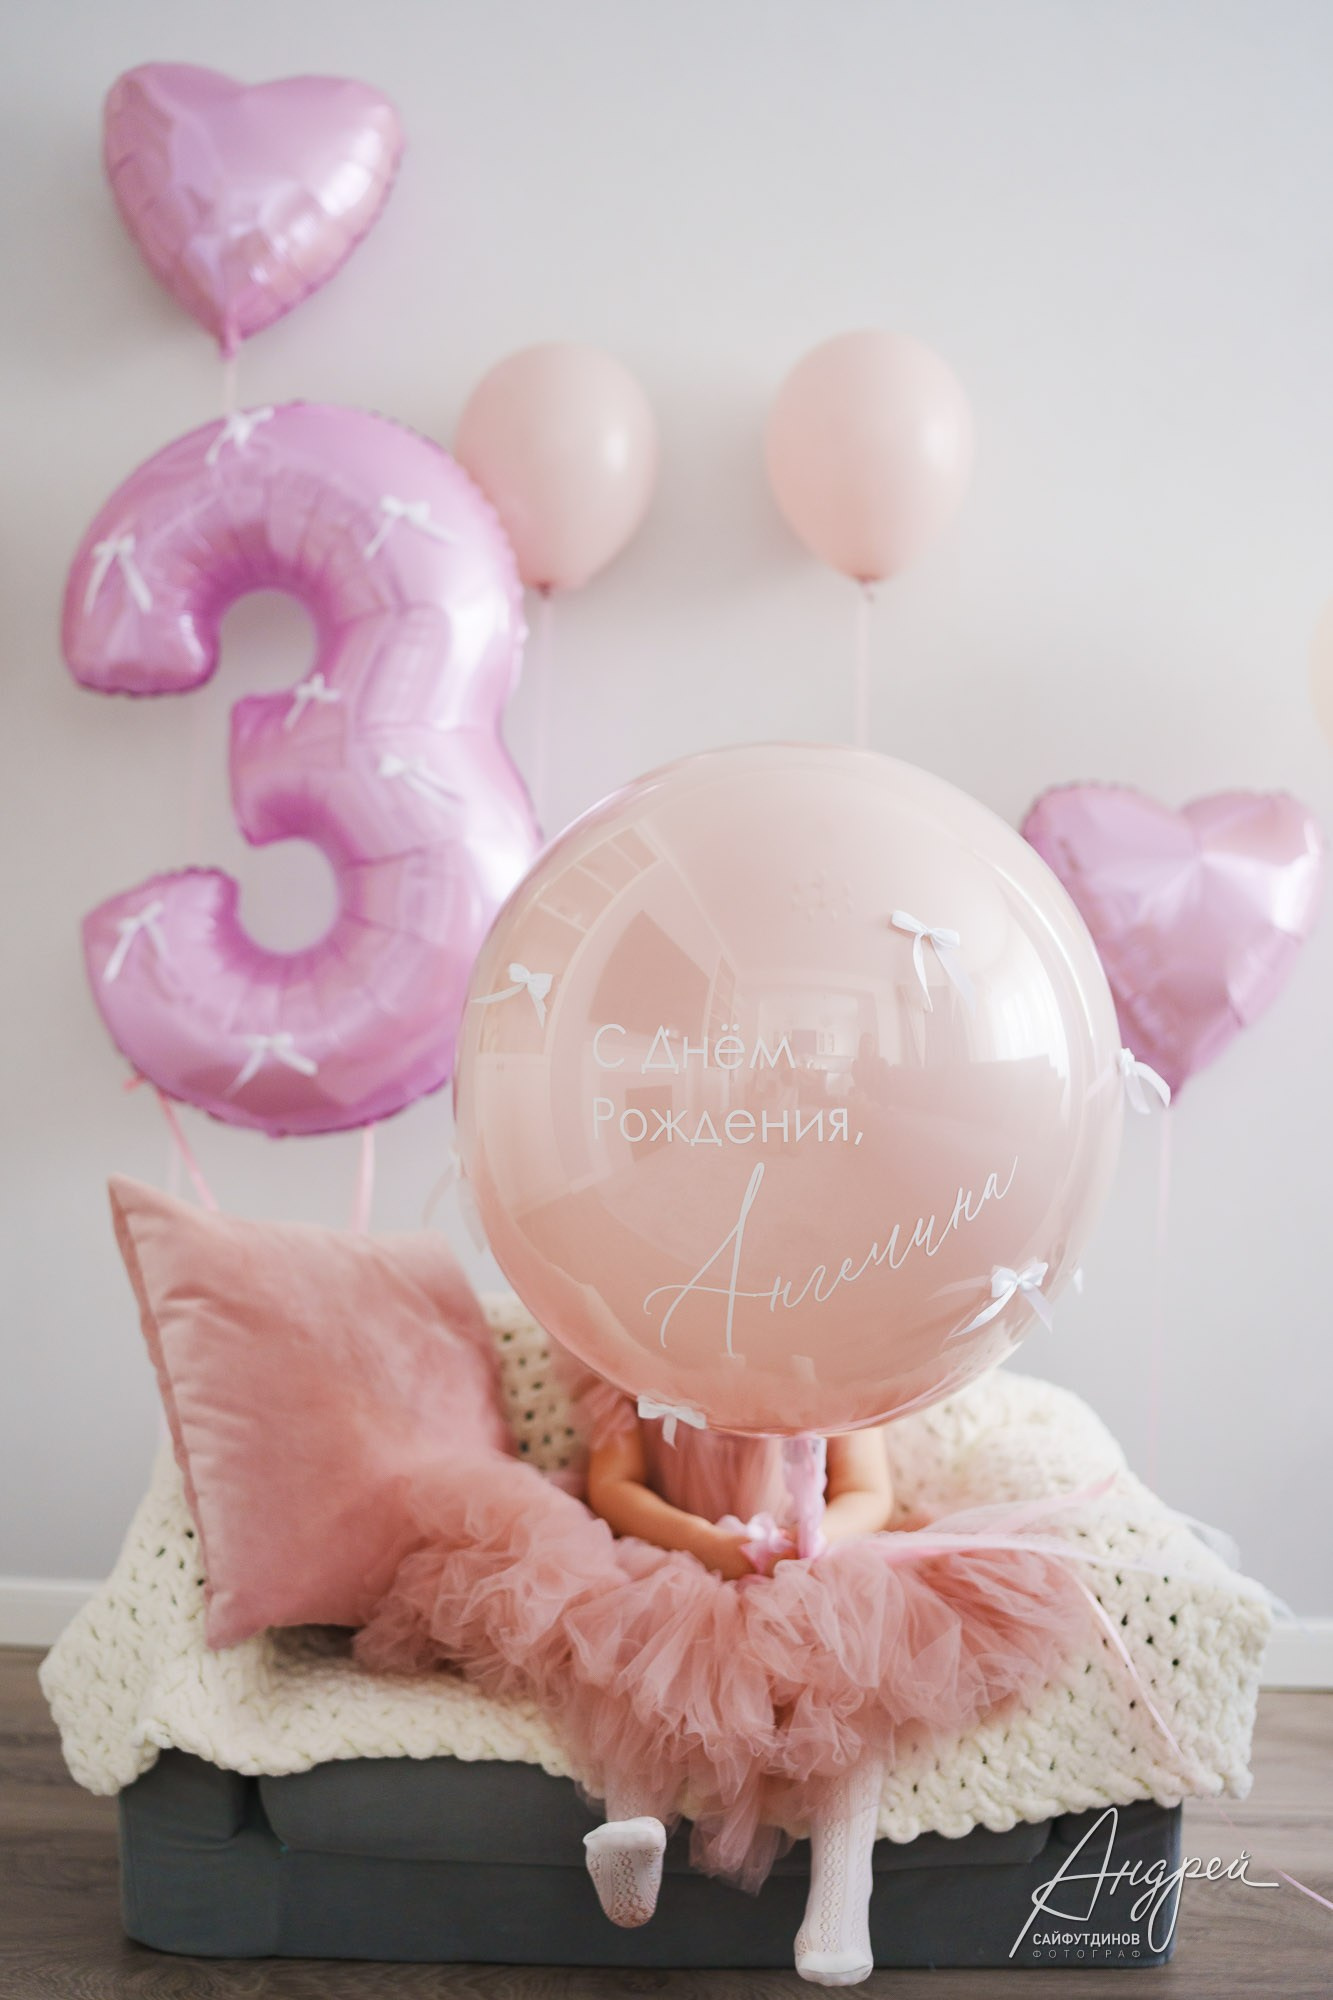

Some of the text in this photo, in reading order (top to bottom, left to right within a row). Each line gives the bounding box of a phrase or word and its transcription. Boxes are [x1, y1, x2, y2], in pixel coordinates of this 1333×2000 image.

[62, 400, 545, 1138] 3
[641, 1023, 797, 1075] Днём
[592, 1097, 864, 1146] Рождения,
[643, 1155, 1018, 1359] Ангелина
